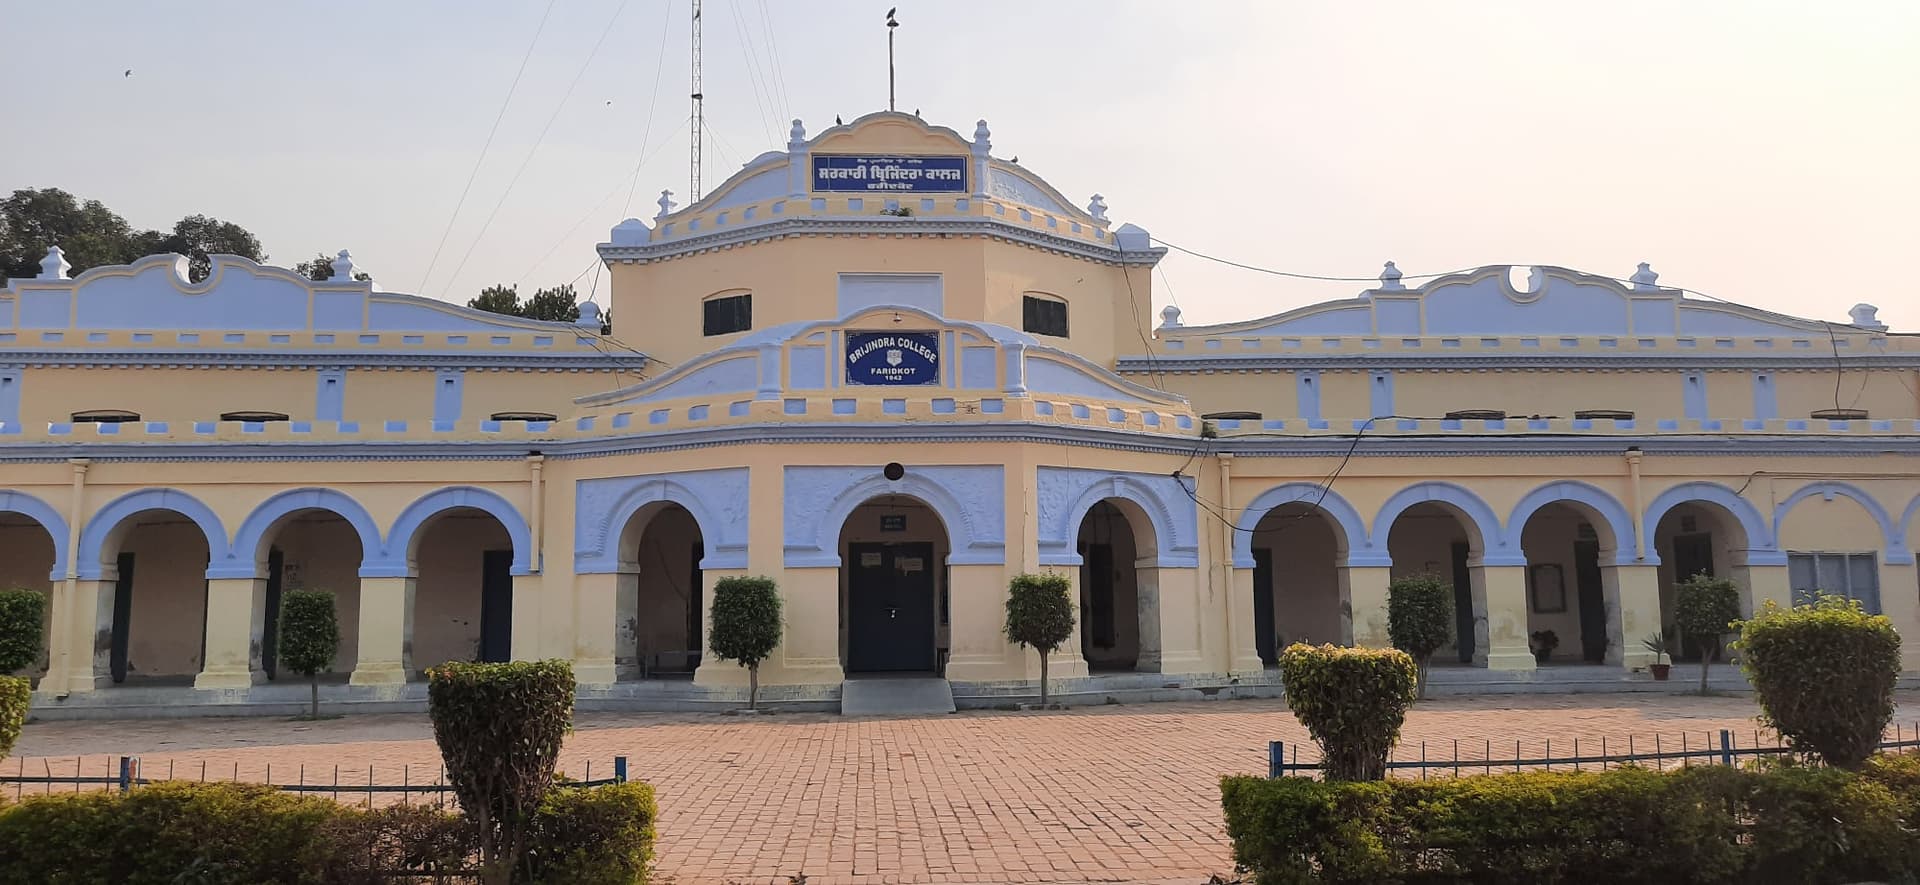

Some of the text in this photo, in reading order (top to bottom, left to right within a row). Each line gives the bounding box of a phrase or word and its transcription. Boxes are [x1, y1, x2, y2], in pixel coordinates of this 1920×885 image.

[818, 165, 867, 180] ਸਰਕਾਰੀ
[925, 168, 961, 180] ਕਾਲਜ
[848, 337, 937, 364] BRIJINDRA COLLEGE
[870, 367, 916, 375] FARIDKOT
